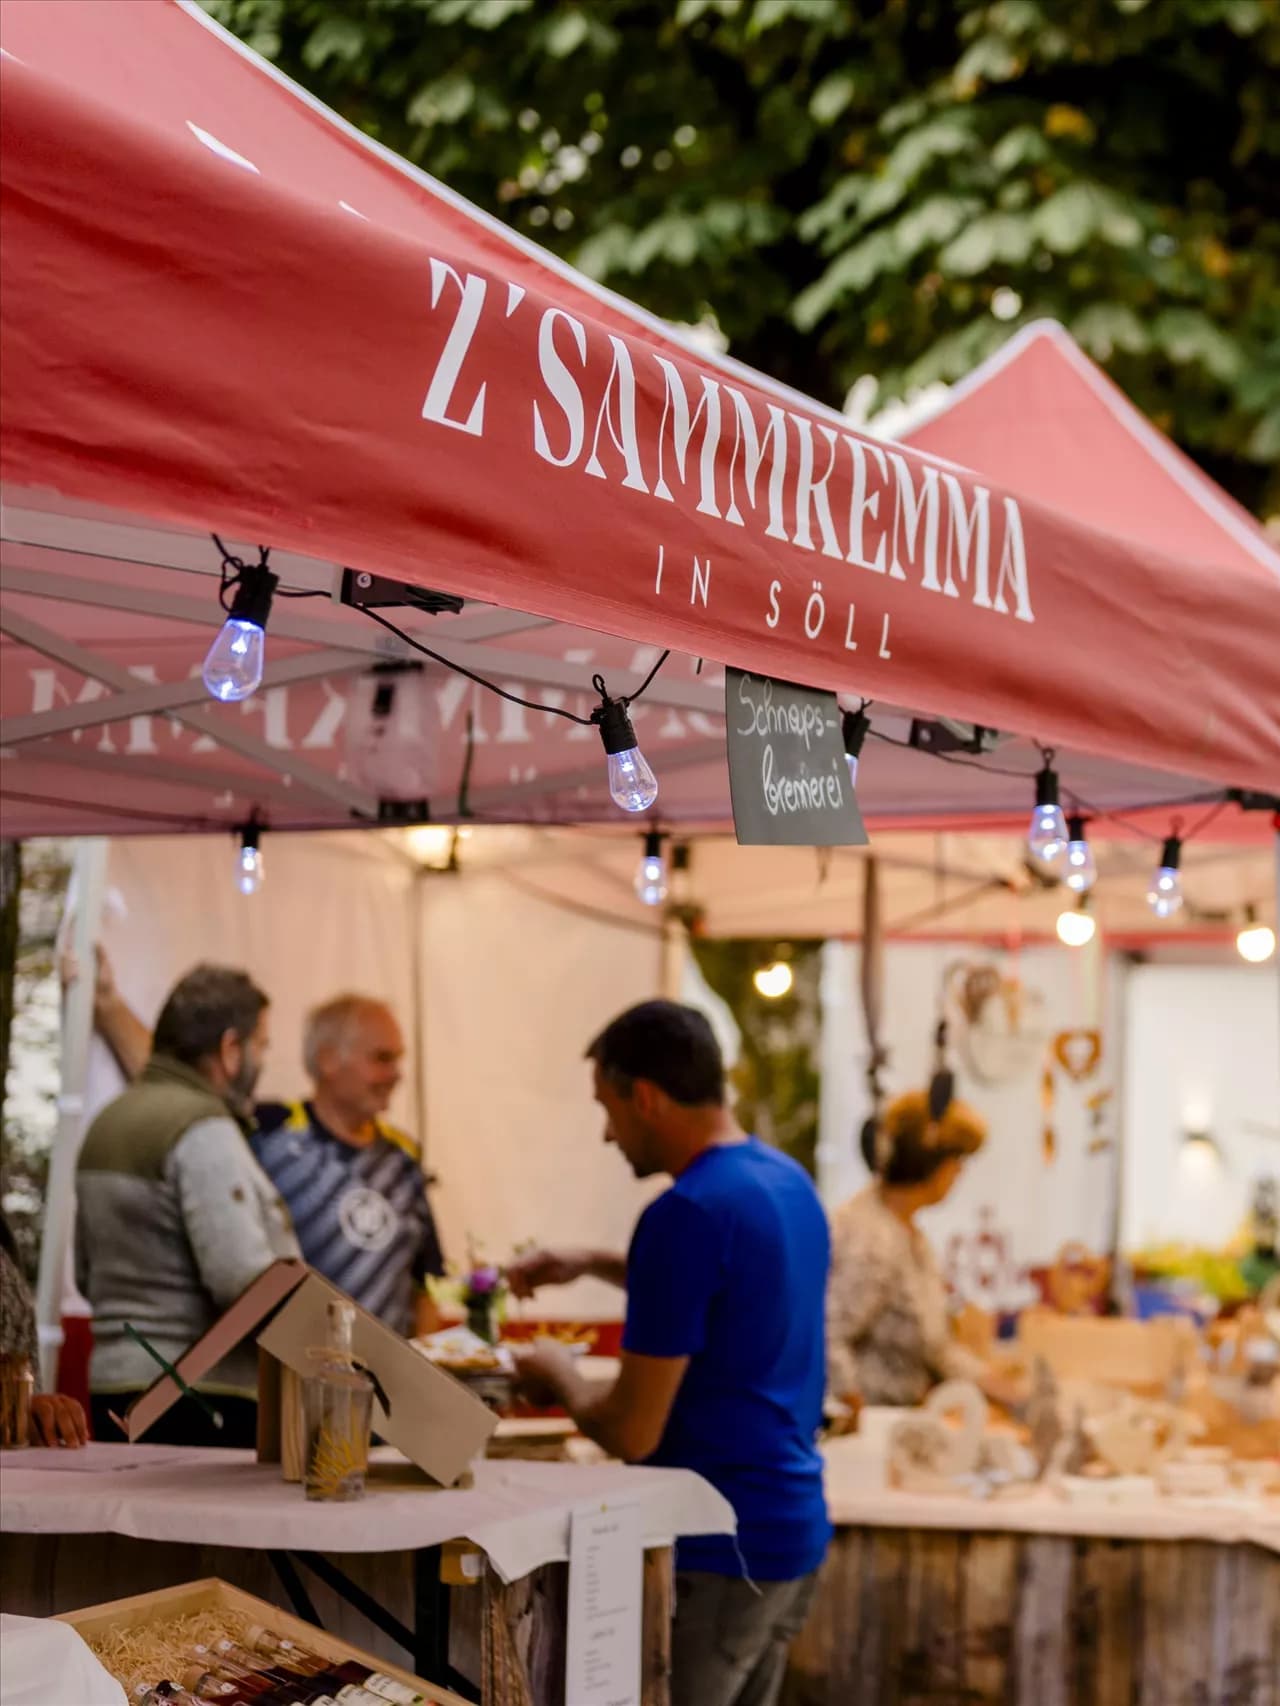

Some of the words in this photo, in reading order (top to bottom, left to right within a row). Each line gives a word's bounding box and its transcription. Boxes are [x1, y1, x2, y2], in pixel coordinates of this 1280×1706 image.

[422, 256, 1035, 623] Z'SAMMKEMMA
[654, 544, 711, 608] IN
[765, 580, 892, 660] SÖLL
[737, 674, 838, 750] Schnaps-
